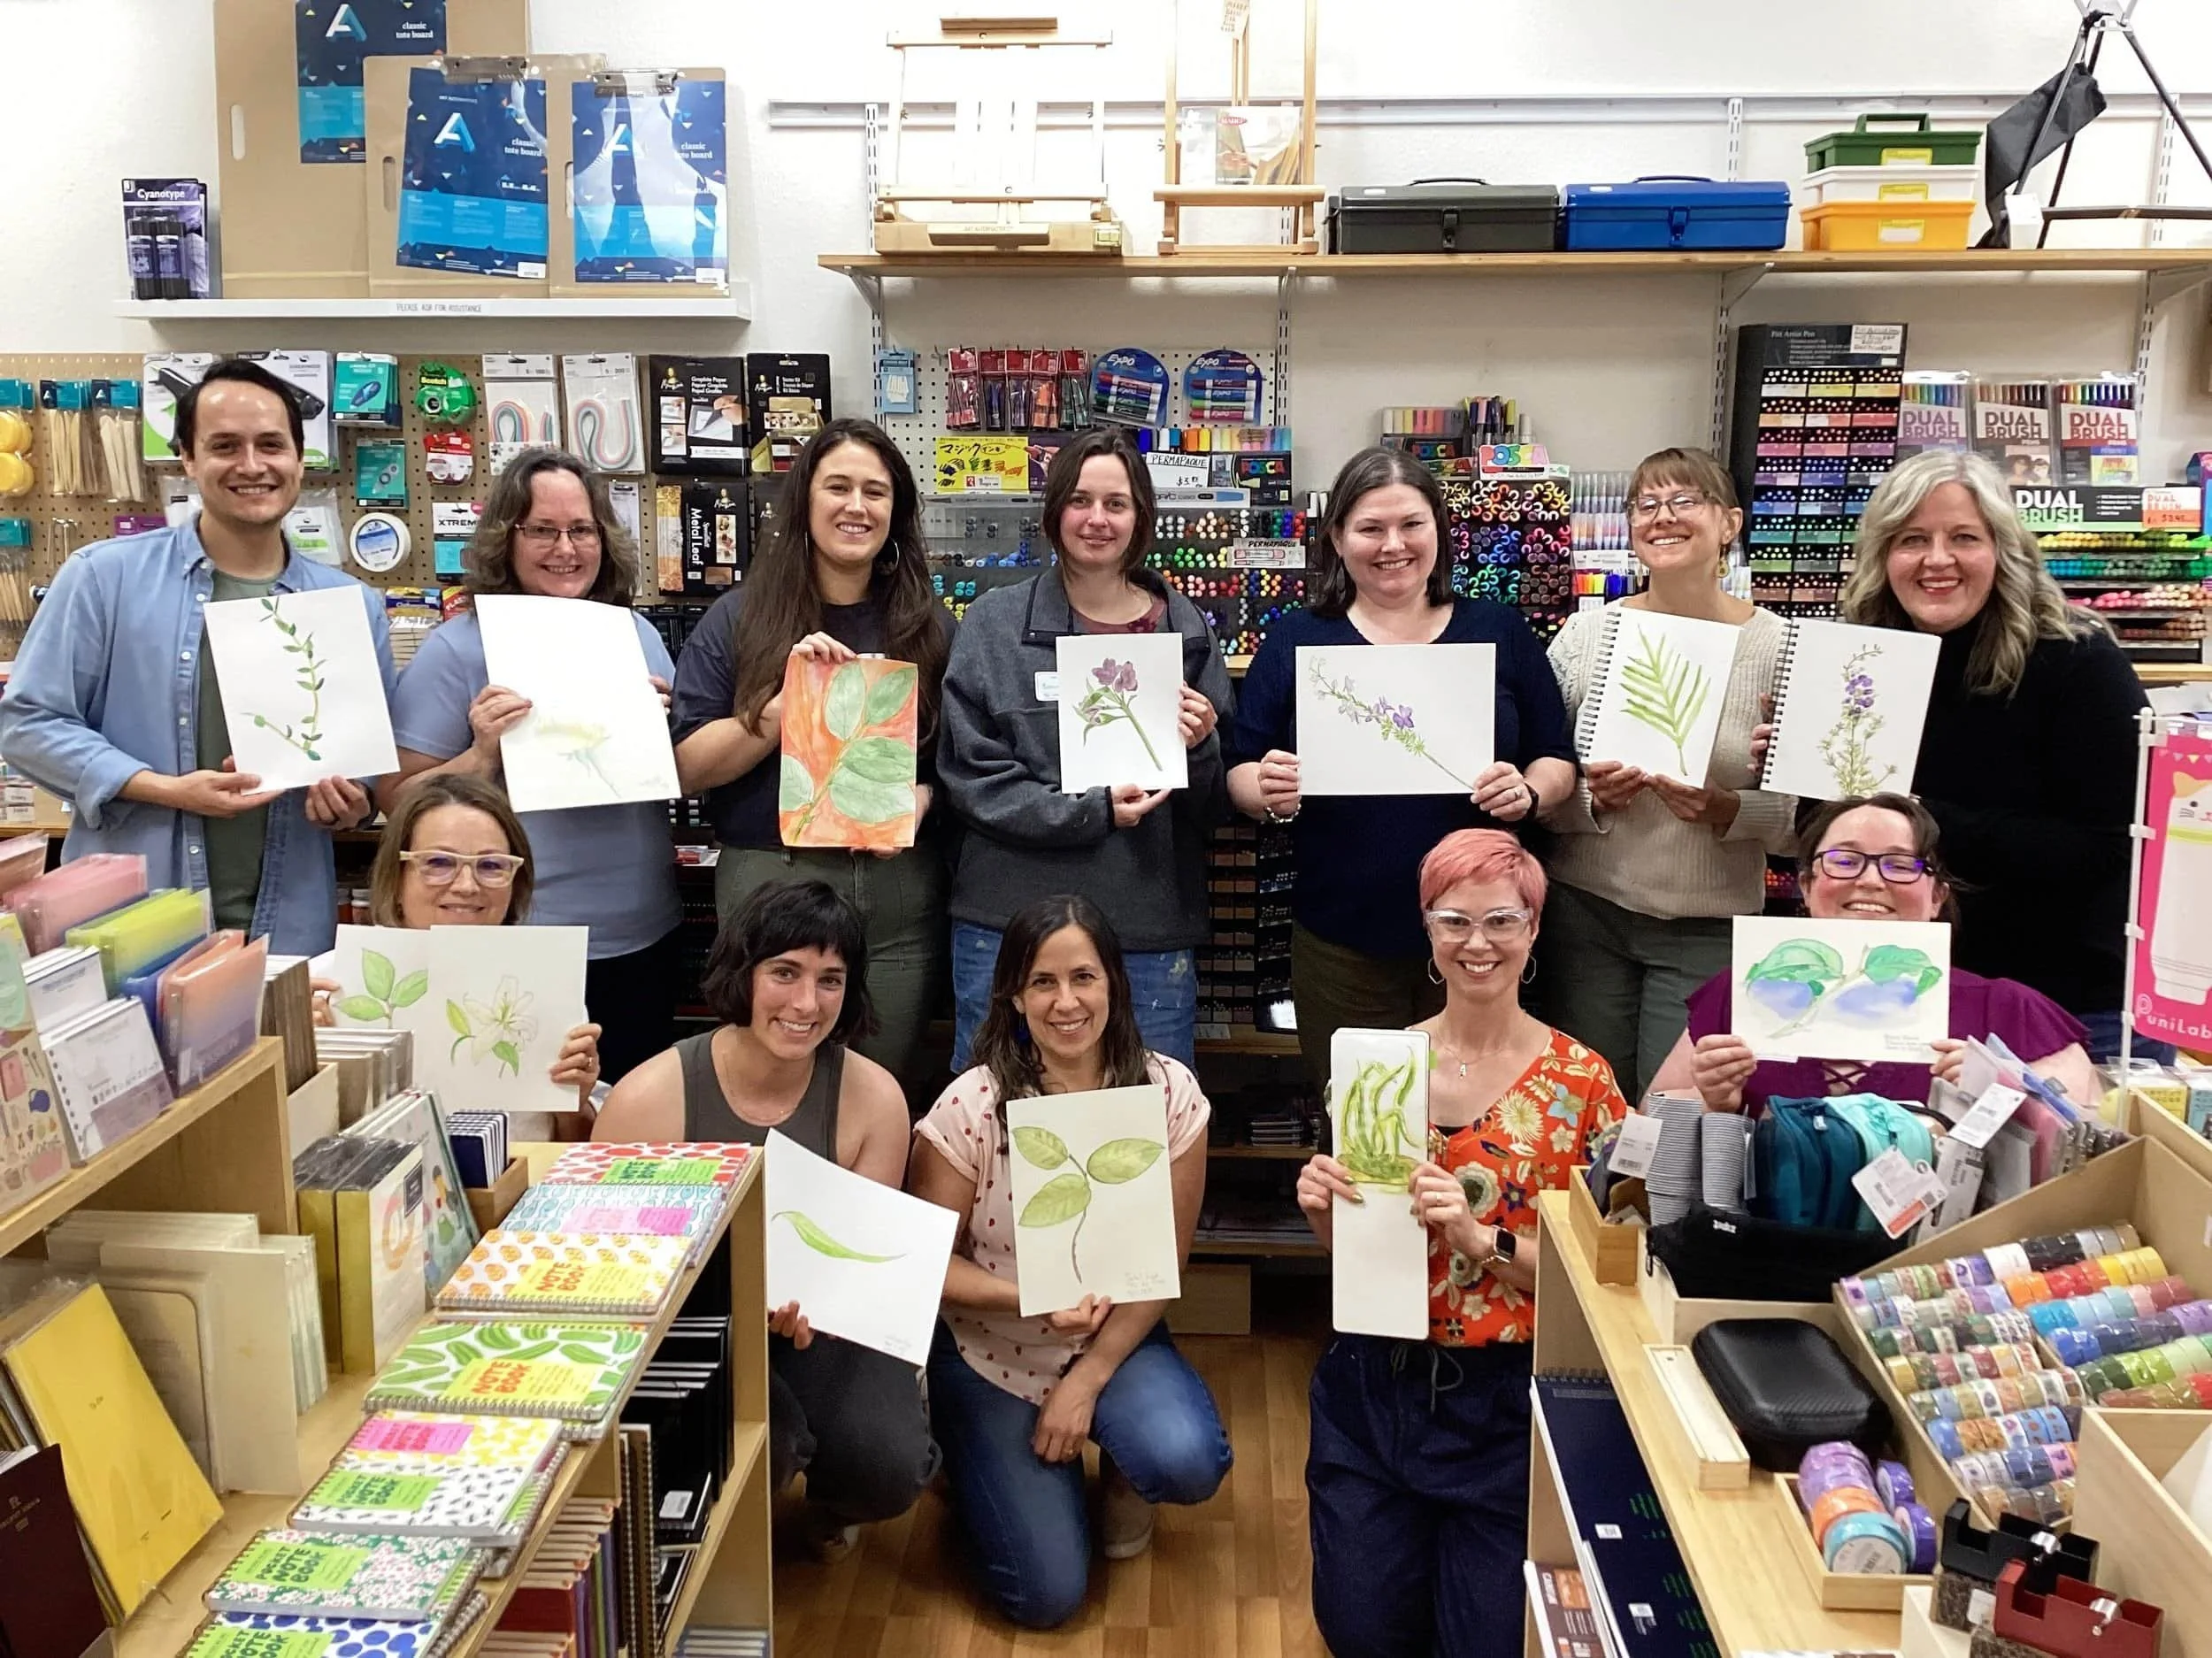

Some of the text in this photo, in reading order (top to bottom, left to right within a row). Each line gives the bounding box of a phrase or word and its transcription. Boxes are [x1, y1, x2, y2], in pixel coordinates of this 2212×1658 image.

[137, 189, 185, 200] Cyanotype
[1108, 354, 1134, 366] EXPO
[1195, 357, 1219, 368] EXPO
[1903, 411, 1959, 426] DUAL
[1985, 411, 2042, 426] DUAL
[2070, 412, 2129, 426] DUAL
[1903, 425, 1960, 439] BRUSH
[1985, 426, 2042, 440] BRUSH
[2070, 426, 2129, 440] BRUSH
[1152, 454, 1208, 467] PERMAPAQUE
[1479, 444, 1548, 466] POSCA
[1240, 460, 1285, 475] POSCA
[2016, 490, 2084, 509] DUAL
[2147, 494, 2177, 503] DUAL
[438, 518, 478, 527] XTREM
[2018, 508, 2084, 523] BRUSH
[690, 508, 704, 566] Metal Leaf
[535, 1262, 572, 1292] NOTE
[557, 1265, 591, 1292] BOOK
[471, 1361, 512, 1394] NOTE
[494, 1363, 531, 1393] BOOK
[351, 1476, 387, 1505] NOTE
[368, 1478, 399, 1505] BOOK
[255, 1546, 290, 1580] POCKET
[273, 1547, 311, 1582] NOTE
[290, 1551, 326, 1583] BOOK
